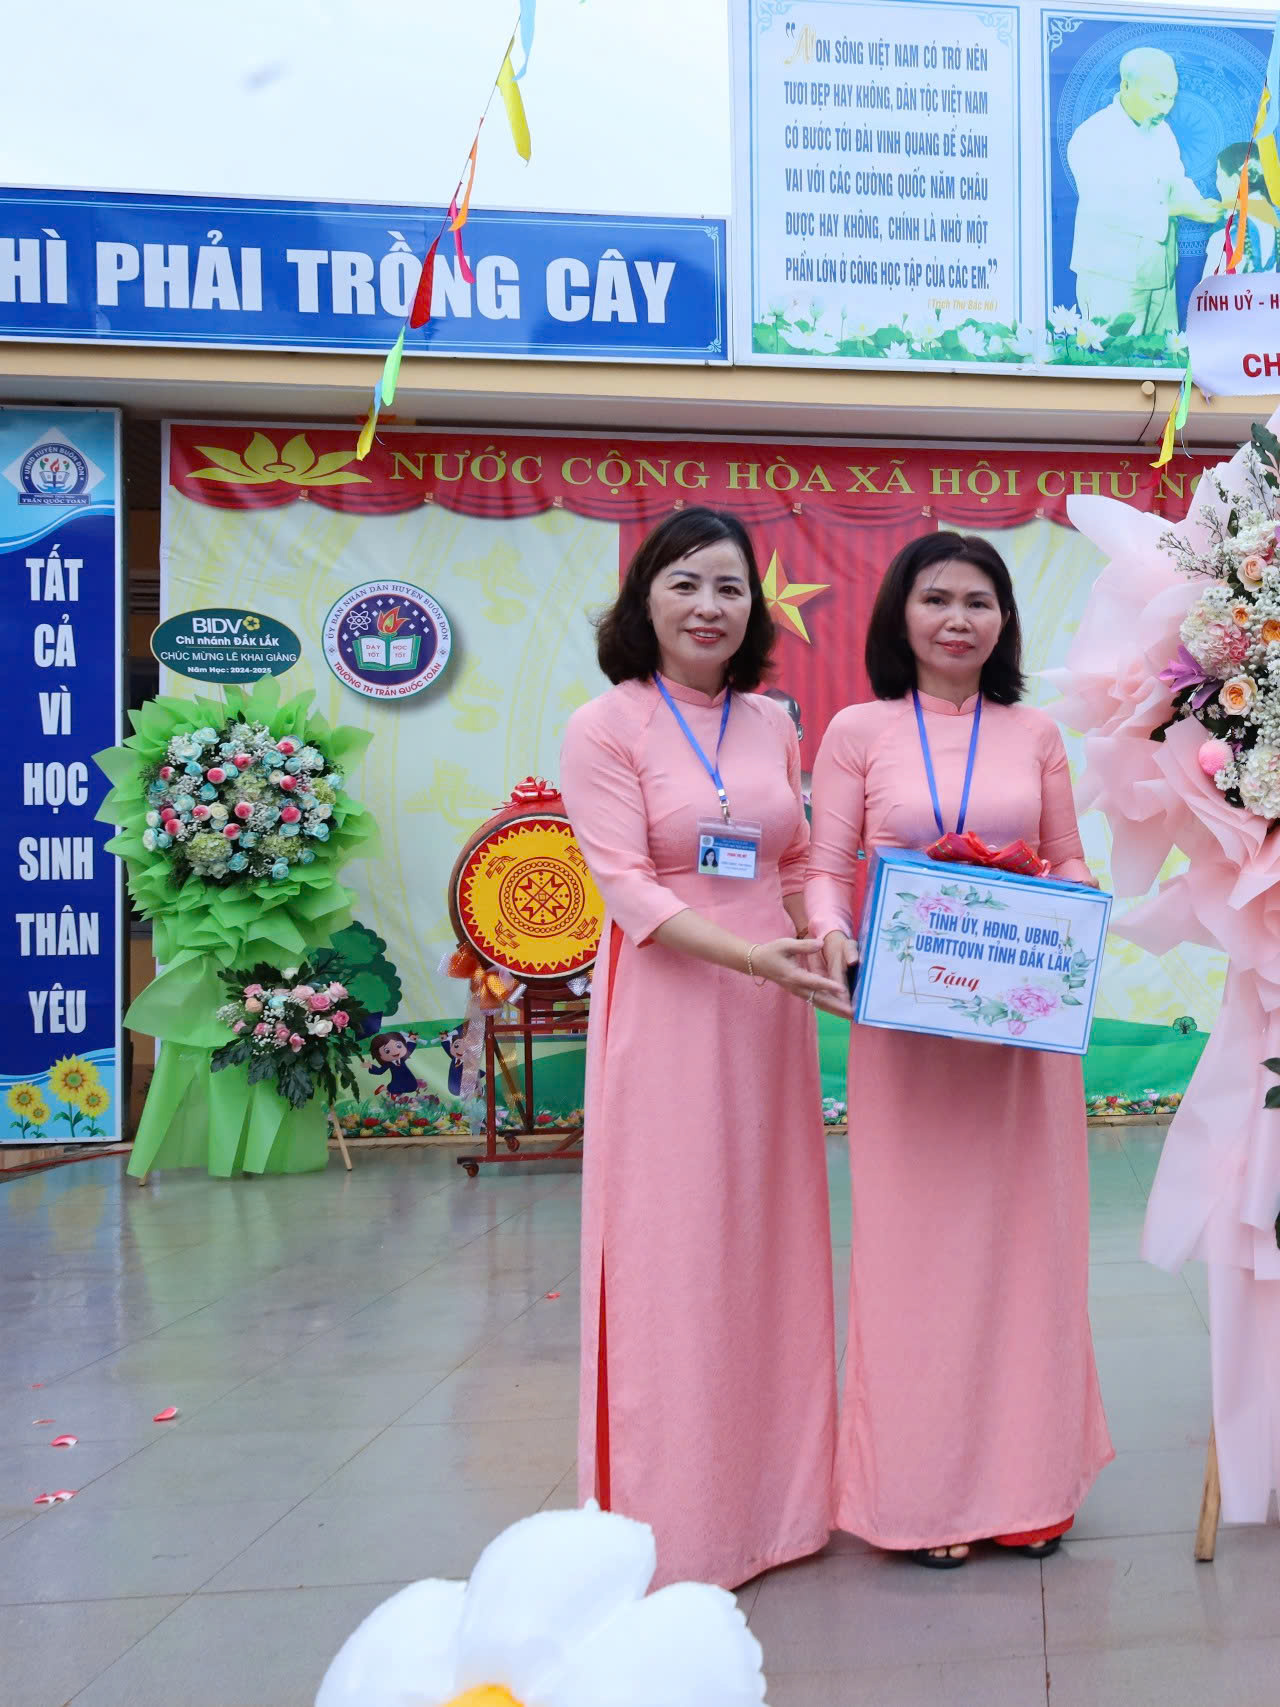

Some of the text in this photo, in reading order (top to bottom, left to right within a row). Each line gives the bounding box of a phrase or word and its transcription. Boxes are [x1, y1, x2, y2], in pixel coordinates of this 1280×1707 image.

[835, 35, 988, 71] SÔNG VIỆT NAM CÓ TRỞ NÊN
[811, 82, 830, 111] ĐẸP
[834, 83, 853, 108] HAY
[856, 79, 893, 112] KHÔNG,
[896, 81, 917, 111] DÂN
[920, 82, 938, 117] TỘC
[941, 84, 962, 118] VIỆT
[965, 90, 988, 115] NAM
[785, 119, 988, 158] CÓ BƯỚC TỚI ĐÀI VINH QUANG SÁNH
[785, 163, 988, 201] VAI VỚI CÁC CƯỜNG QUỐC NĂM CHÂU
[786, 209, 988, 249] ĐƯỢC HAY KHÔNG, CHÍNH LÀ NHỜ MỘT
[0, 228, 676, 323] HÌ PHẢI TRỒNG CÂY
[786, 250, 968, 292] PHẦN LỚN CÔNG HỌC TẬP CỦA CÁC
[1196, 289, 1229, 312] TỈNH
[389, 445, 543, 485] NƯỚC
[561, 449, 710, 495] CỘNG
[725, 455, 836, 492] HÒA
[845, 459, 915, 495] XÃ
[928, 460, 1020, 504] HỘI
[1036, 460, 1140, 499] CHỦ
[25, 543, 84, 602] TẤT
[192, 617, 243, 634] BIDV
[325, 583, 449, 641] ỦY BAN NHÂN DÂN HUYỆN BUÔN ĐÔN
[34, 613, 77, 668] CẢ
[160, 650, 190, 660] CHÚC
[192, 650, 224, 661] MỪNG
[240, 653, 264, 661] KHAI
[265, 651, 297, 662] GIẢNG
[175, 633, 280, 647] Chi nhánh ĐẮK LẮK
[187, 666, 208, 674] Năm
[334, 661, 361, 689] TRƯỜNG
[362, 684, 373, 694] TH
[375, 685, 397, 697] TRẦN
[398, 679, 424, 695] QUỐC
[38, 685, 72, 735] VÌ
[23, 761, 89, 814] HỌC
[18, 836, 94, 881] SINH
[15, 904, 100, 957] THÂN
[929, 909, 959, 934] TỈNH
[982, 920, 1021, 944] HĐND,
[1024, 926, 1064, 949] UBND,
[915, 934, 1073, 973] UBMTTQVN TỈNH ĐẮK LẮK
[928, 965, 980, 992] Tặng
[28, 982, 87, 1034] YÊU
